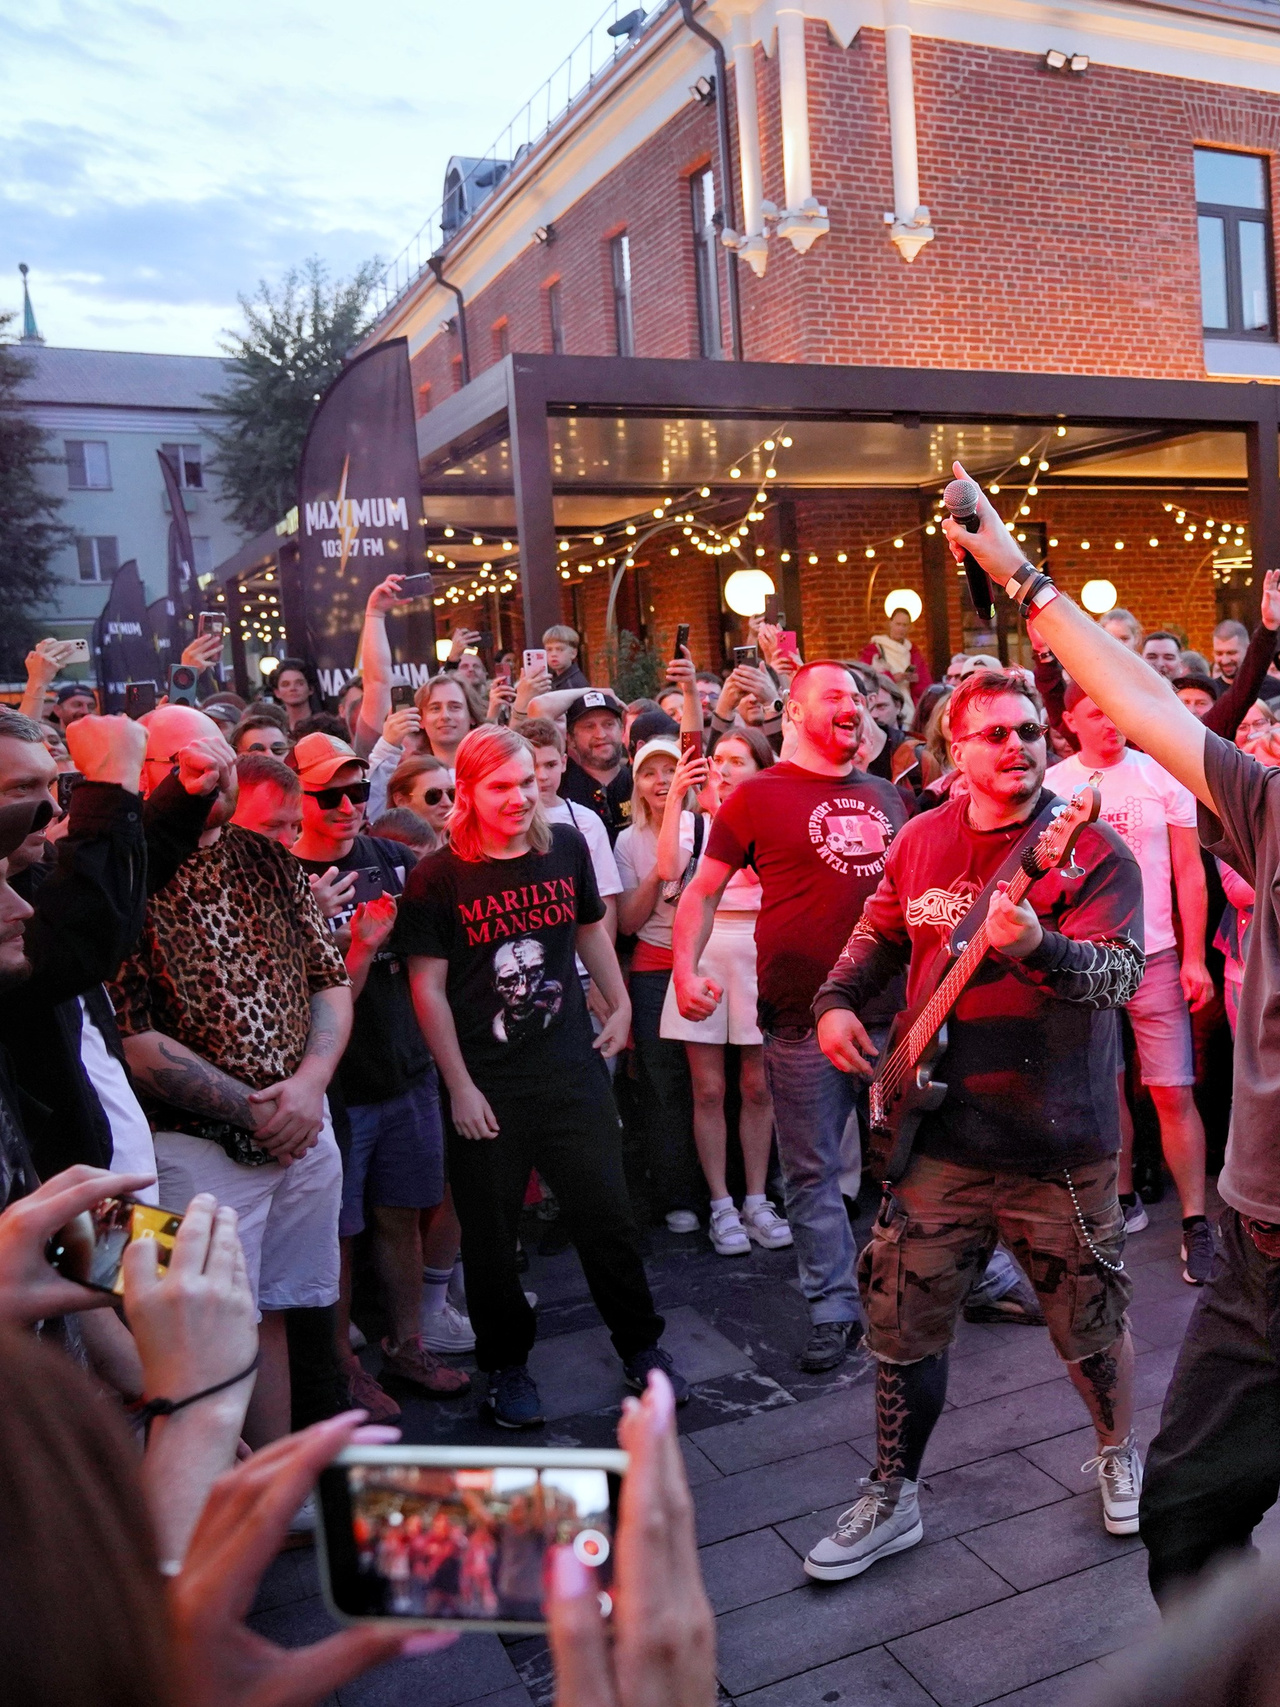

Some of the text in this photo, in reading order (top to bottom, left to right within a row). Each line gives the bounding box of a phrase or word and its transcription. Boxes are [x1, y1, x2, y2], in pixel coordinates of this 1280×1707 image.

[305, 497, 409, 536] MAXIMUM
[362, 538, 384, 556] FM
[808, 798, 894, 844] SUPPORT YOUR LOCAL
[1100, 812, 1129, 822] SKET
[816, 844, 849, 874] TEAM
[458, 876, 576, 924] MARILYN
[466, 901, 575, 946] MANSON
